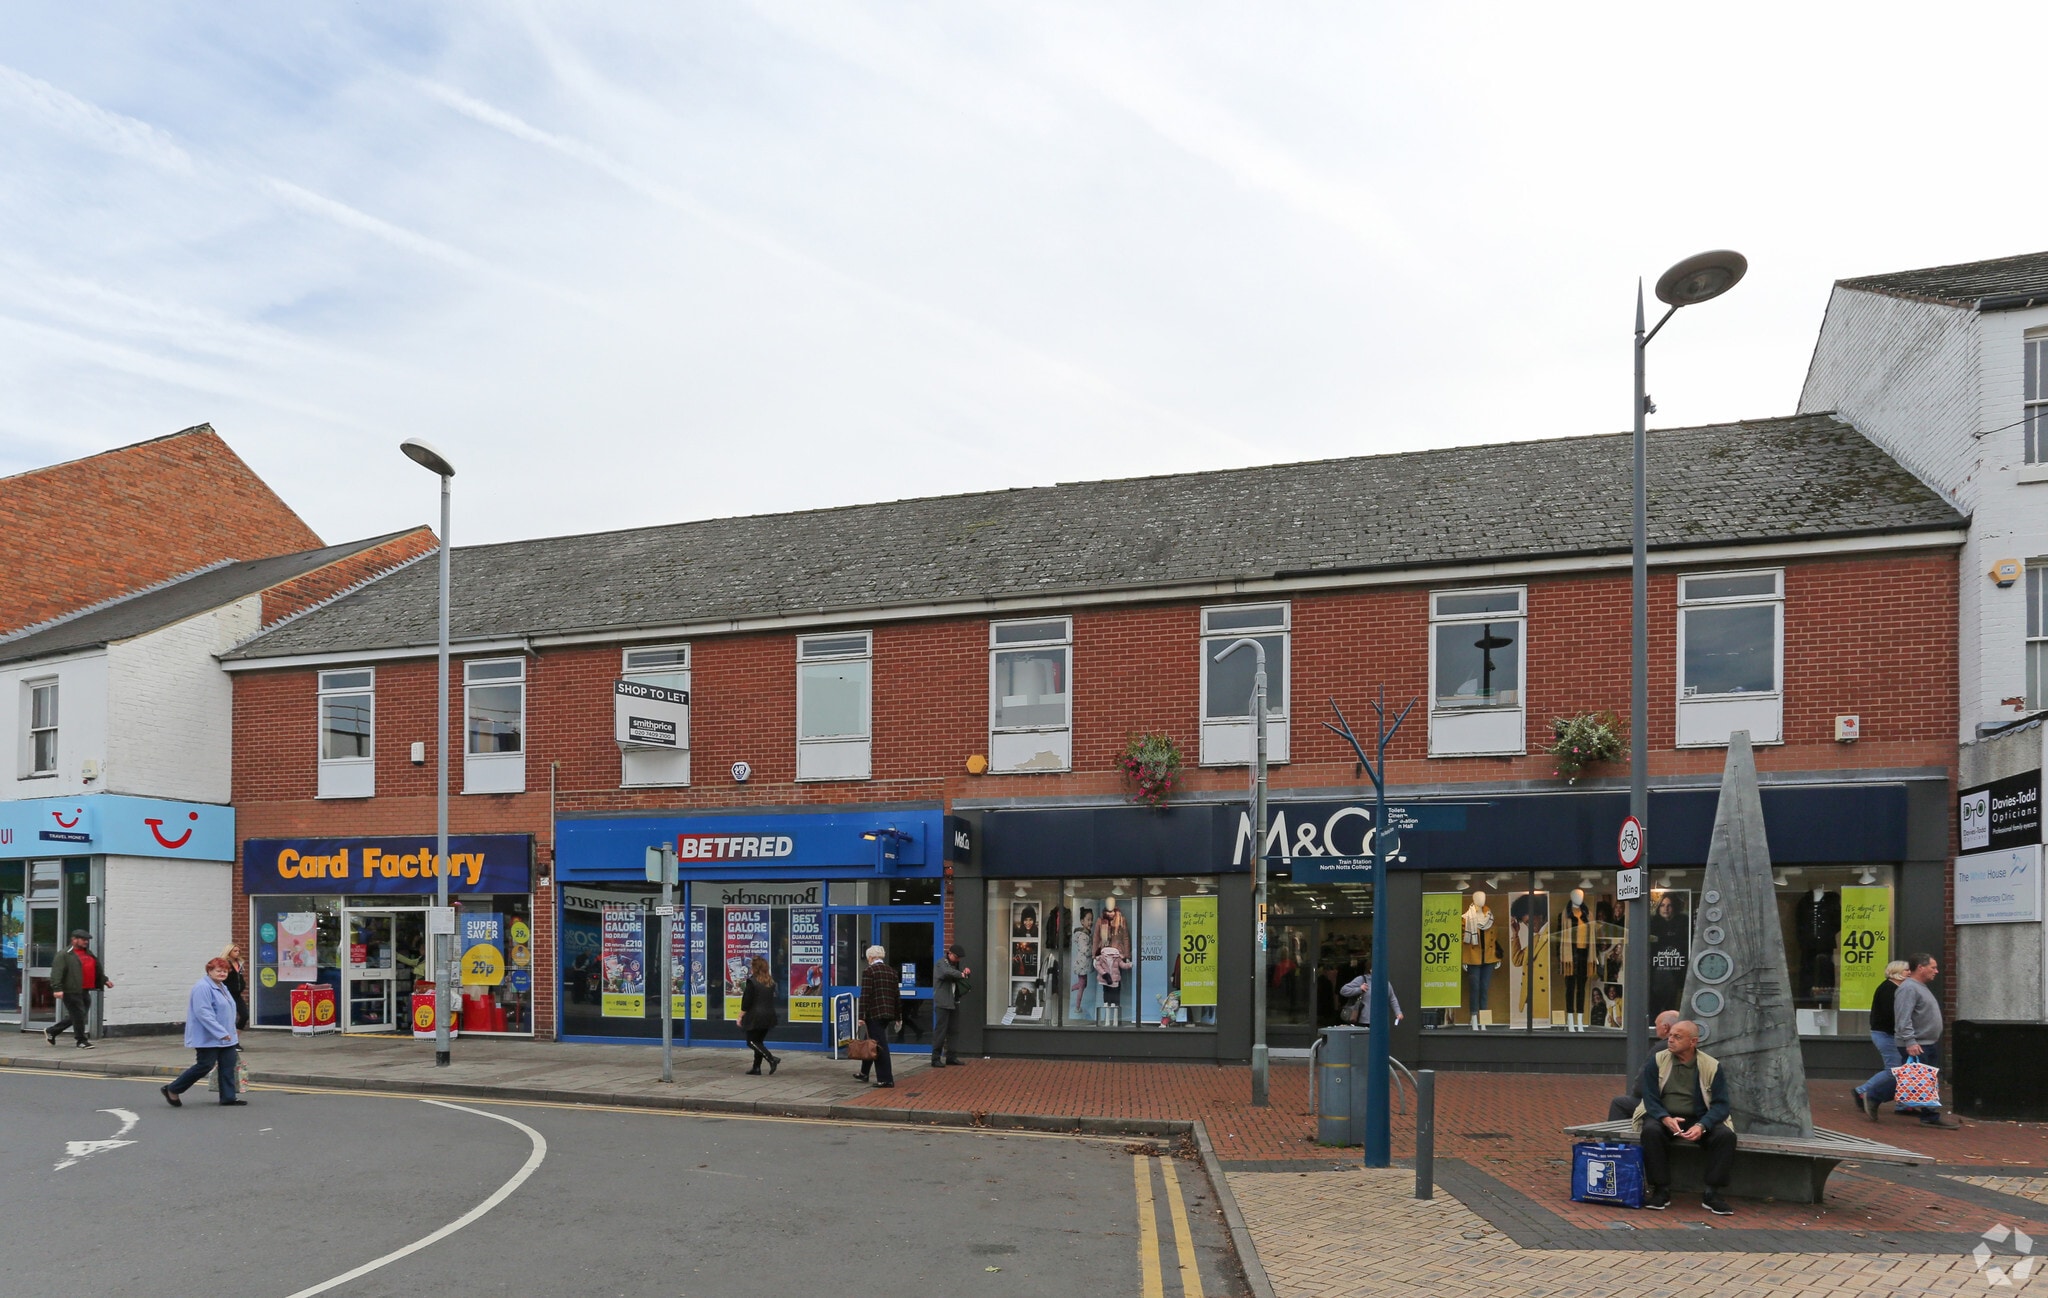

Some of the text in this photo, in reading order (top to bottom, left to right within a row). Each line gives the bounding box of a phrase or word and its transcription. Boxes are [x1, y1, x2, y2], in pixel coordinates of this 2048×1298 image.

[618, 684, 686, 702] SHOP TO LET
[633, 720, 672, 731] smithprice
[1992, 788, 2036, 810] Davies-Todd
[1992, 806, 2037, 823] Opticians
[1963, 825, 1986, 836] Davies-Todd
[682, 836, 793, 858] BETFRED
[278, 848, 349, 879] Card
[1624, 874, 1632, 884] No
[1958, 872, 1969, 882] The
[1987, 869, 2006, 879] House
[1619, 885, 1639, 896] cycling
[2002, 893, 2014, 902] Clinic
[1436, 909, 1450, 918] about
[1846, 904, 1855, 913] It's
[1858, 904, 1875, 915] about
[605, 912, 636, 921] GOALS
[728, 912, 760, 922] GOALS
[792, 914, 816, 923] BEST
[1193, 912, 1207, 920] about
[1424, 917, 1433, 926] get
[1844, 914, 1855, 924] get
[467, 921, 498, 930] SUPER
[605, 923, 642, 932] GALORE
[672, 923, 703, 932] ALRE
[728, 922, 767, 933] GALORE
[792, 924, 819, 933] ODDS
[1182, 920, 1191, 928] get
[1184, 934, 1215, 952] 30%
[1424, 933, 1459, 951] 30%
[1843, 930, 1886, 950] 40%
[1184, 953, 1207, 964] OFF
[1424, 952, 1450, 964] OFF
[1652, 956, 1685, 966] PETITE
[1844, 951, 1874, 964] OFF
[472, 961, 494, 977] 29p
[1590, 1162, 1605, 1186] F
[1606, 1162, 1614, 1188] DEALS
[1590, 1187, 1614, 1195] FULTONS
